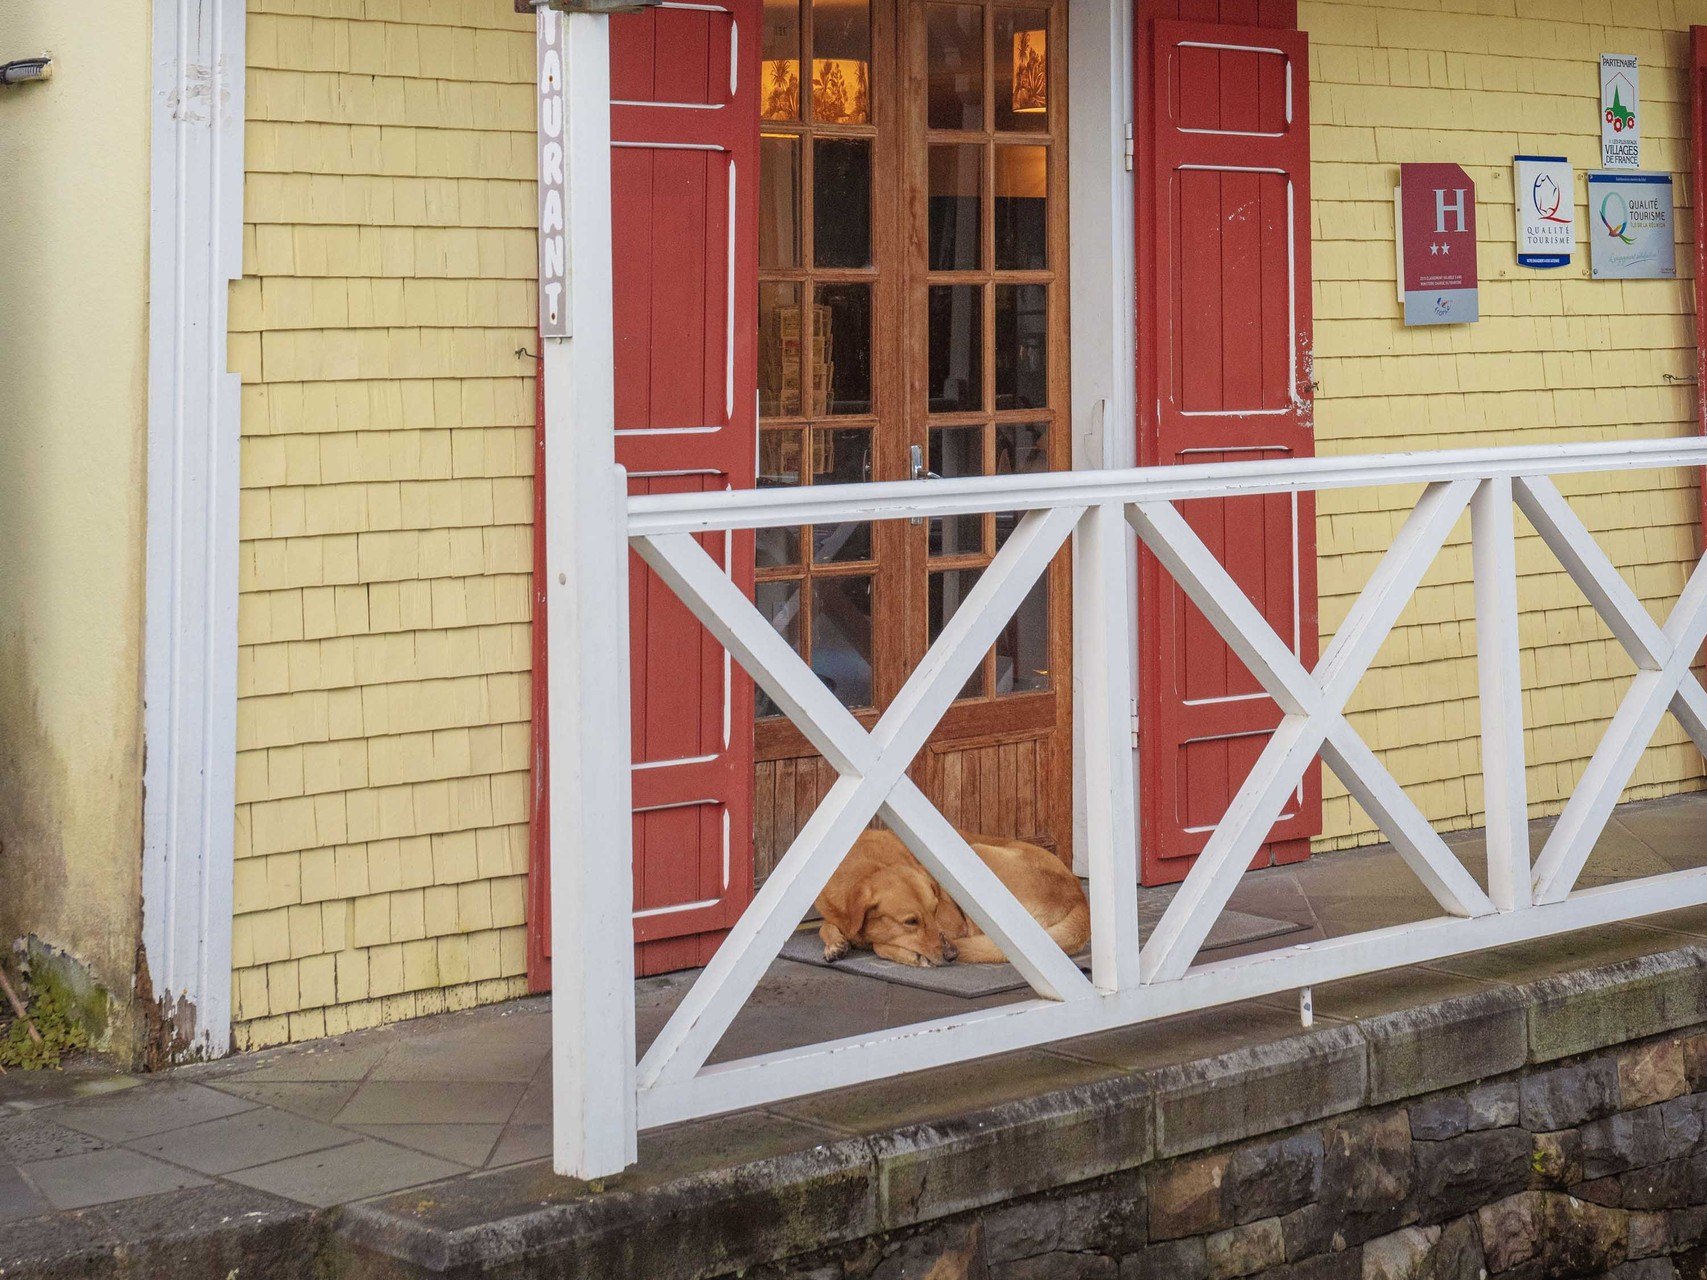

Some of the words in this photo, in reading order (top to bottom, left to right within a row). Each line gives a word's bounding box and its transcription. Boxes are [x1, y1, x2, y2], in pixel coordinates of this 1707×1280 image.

[1602, 58, 1637, 68] PARTENAIRE
[1604, 145, 1638, 156] VILLAGES
[1606, 155, 1614, 163] DE
[1614, 156, 1638, 164] FRANCE
[1628, 198, 1658, 210] QUALITÉ
[1431, 188, 1469, 233] H
[1629, 211, 1666, 221] TOURISME
[1527, 225, 1569, 235] QUALITÉ
[1527, 236, 1570, 244] TOURISME
